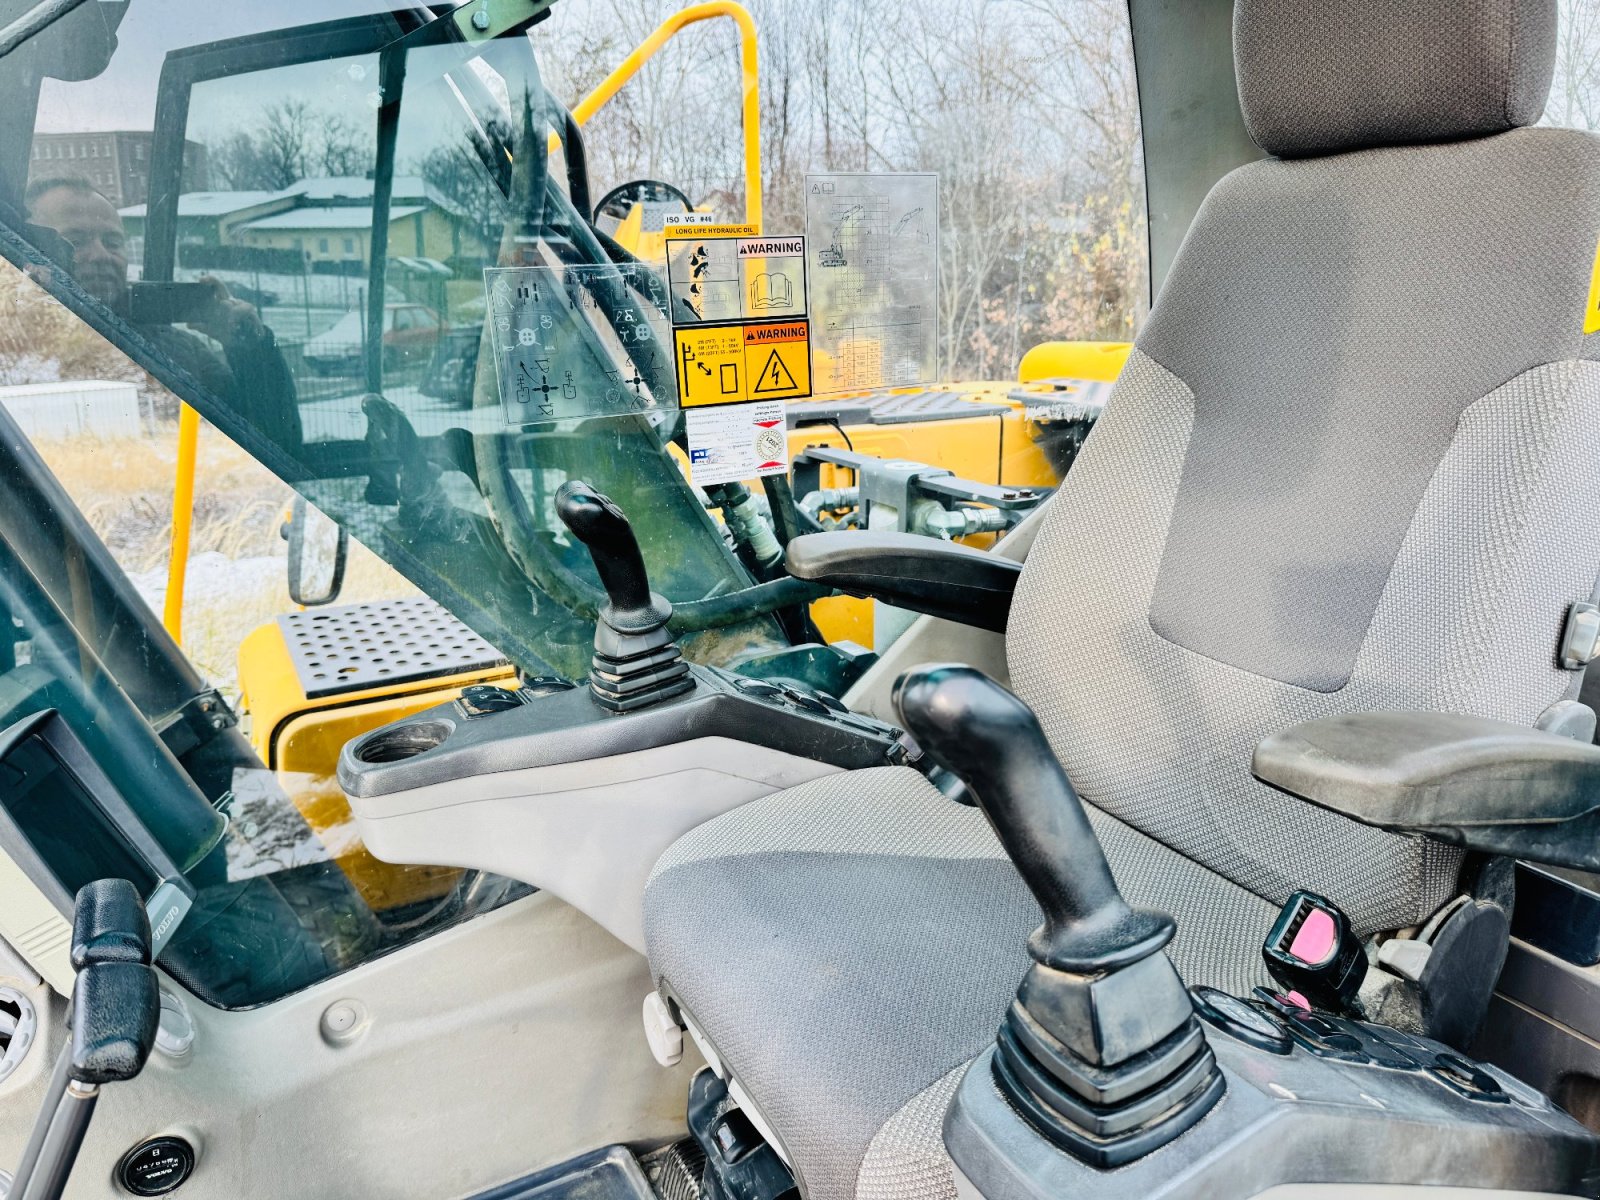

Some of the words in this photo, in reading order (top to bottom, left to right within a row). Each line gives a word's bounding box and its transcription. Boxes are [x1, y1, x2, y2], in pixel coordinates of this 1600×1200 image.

[747, 242, 802, 253] WARNING
[757, 327, 805, 339] WARNING
[152, 906, 179, 940] VOLVO
[145, 1169, 172, 1179] VOLVO
